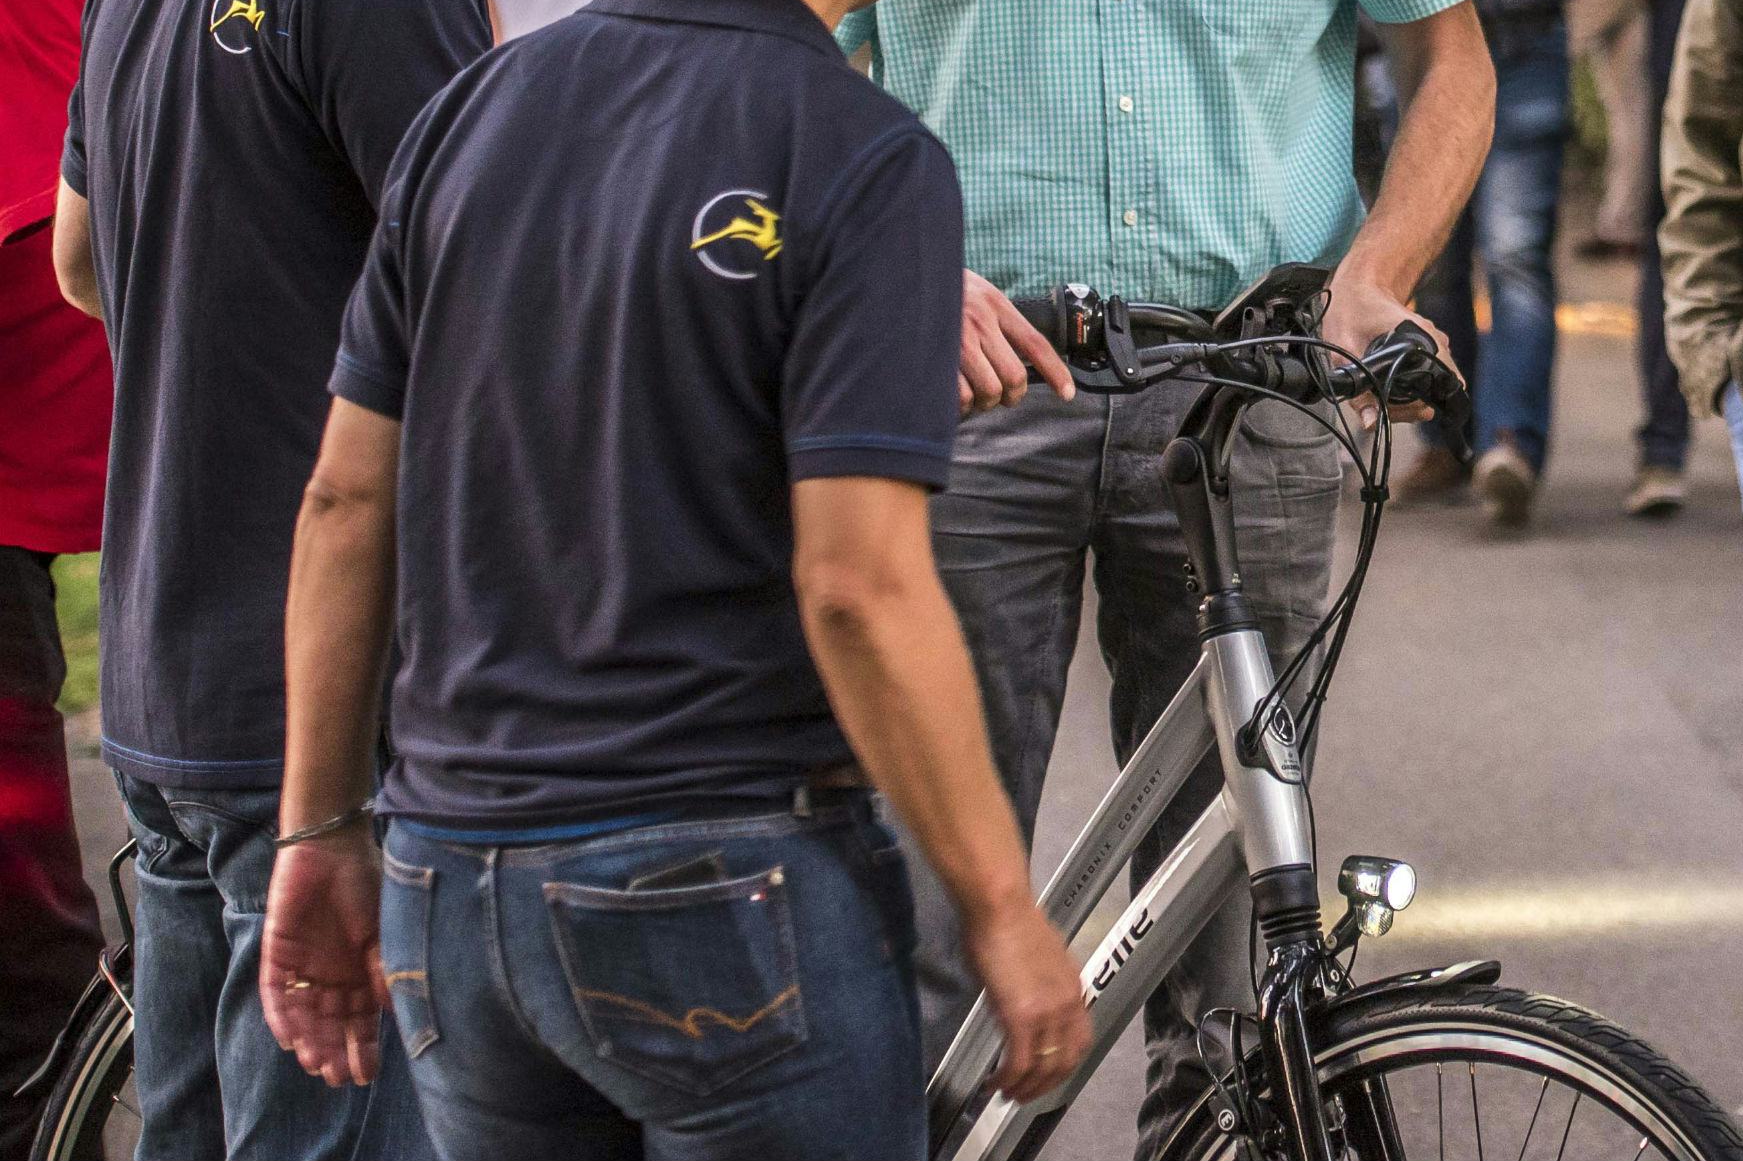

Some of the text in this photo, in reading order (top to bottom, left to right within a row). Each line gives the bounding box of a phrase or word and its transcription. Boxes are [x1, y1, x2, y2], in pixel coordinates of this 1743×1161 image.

[1064, 769, 1162, 908] CHAMONIX COMFORT
[1083, 907, 1154, 1010] elle
